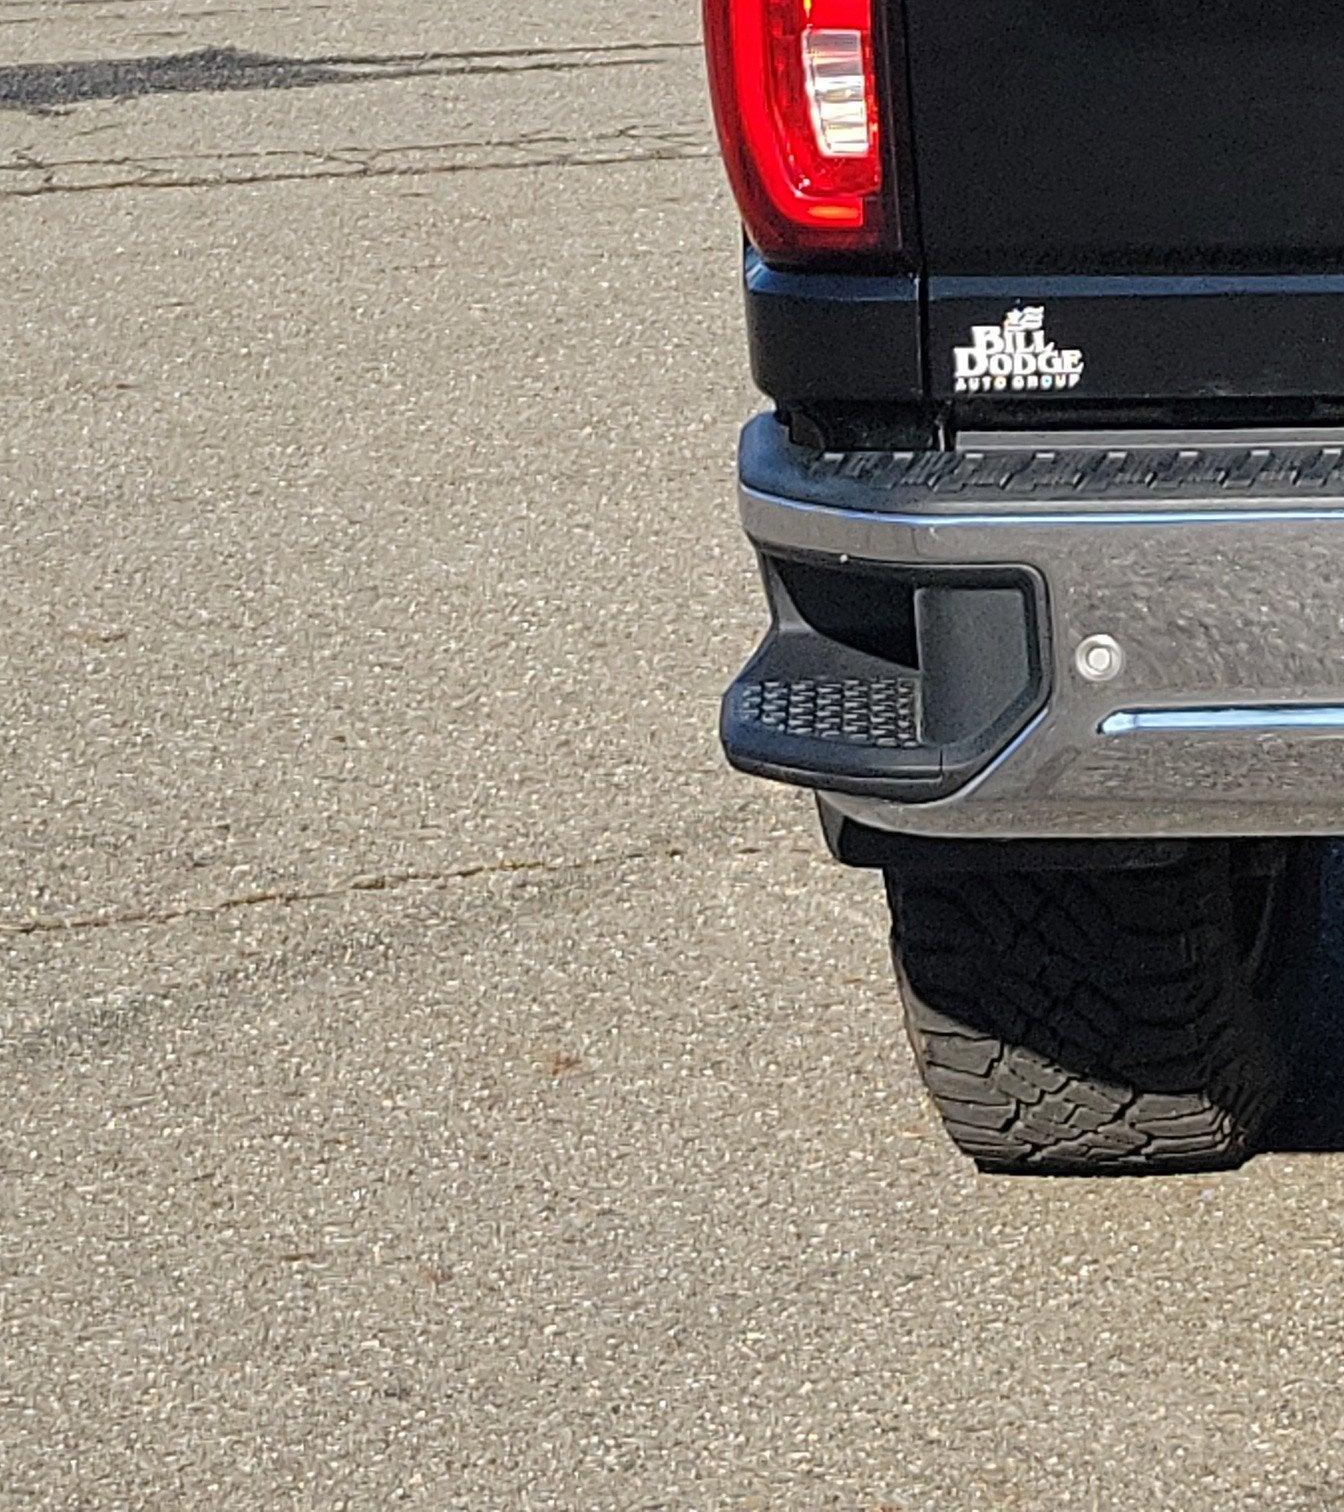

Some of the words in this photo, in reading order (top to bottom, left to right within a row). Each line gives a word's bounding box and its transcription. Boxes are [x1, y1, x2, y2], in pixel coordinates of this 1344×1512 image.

[953, 347, 1085, 377] DODGE
[954, 375, 1008, 393] AUTO
[1011, 373, 1081, 391] GROUP
